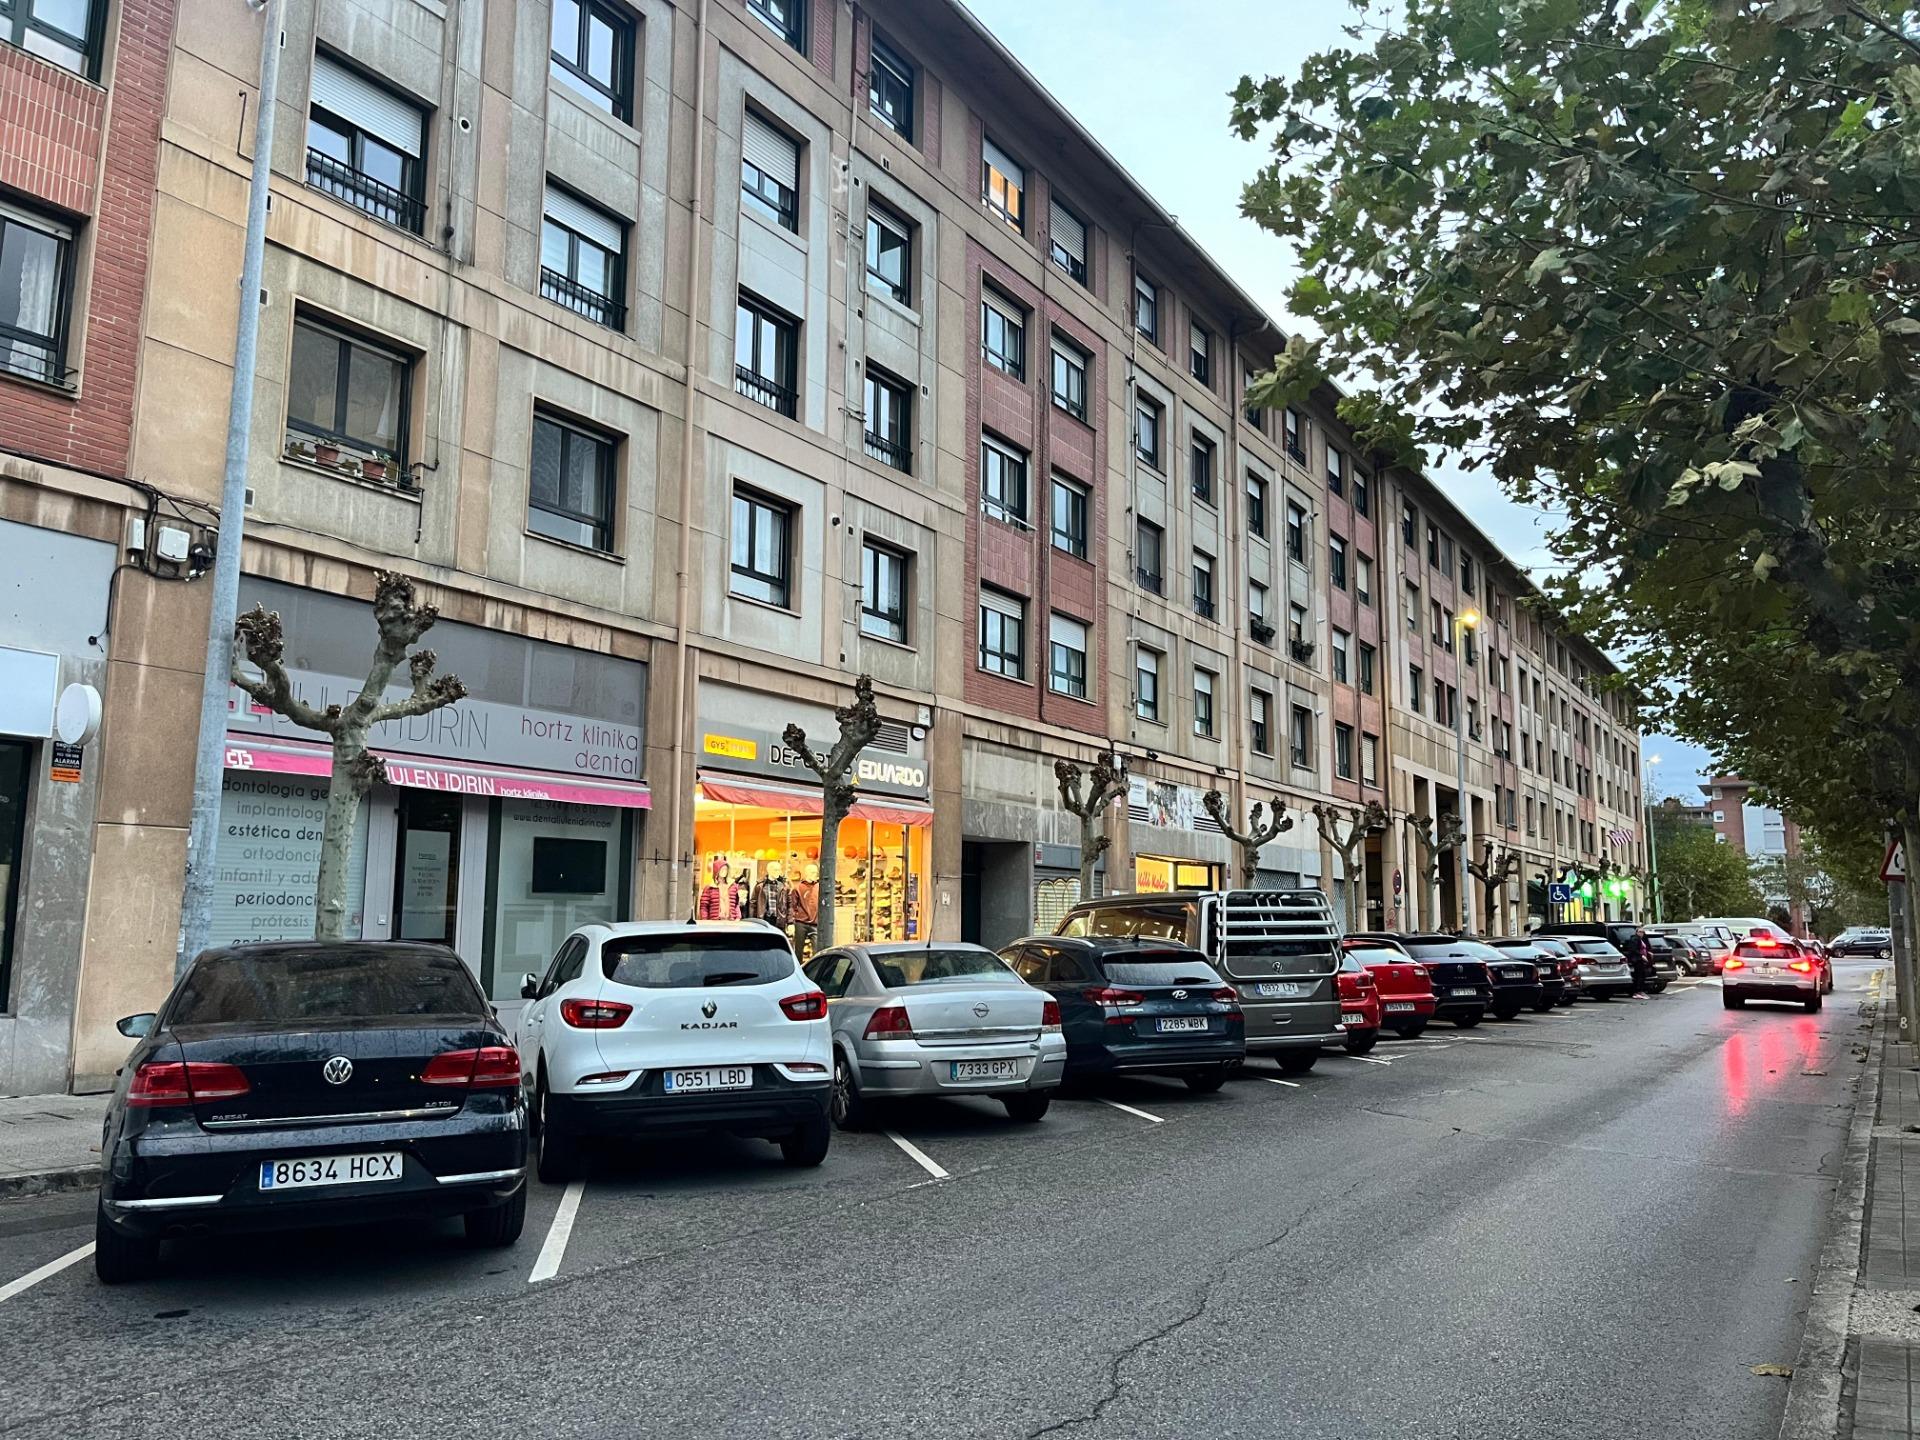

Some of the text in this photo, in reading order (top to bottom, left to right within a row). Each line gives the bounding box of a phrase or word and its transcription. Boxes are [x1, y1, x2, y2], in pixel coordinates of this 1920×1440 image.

[521, 714, 639, 751] hortz klinika
[54, 757, 80, 765] ALARMA
[575, 750, 638, 775] dental
[858, 759, 925, 788] EDUARDO
[222, 778, 305, 799] dontología
[444, 773, 495, 795] IDIRIN
[236, 801, 325, 823] implantolog
[228, 824, 323, 841] estética den
[220, 867, 272, 883] infantil
[278, 872, 286, 886] y
[235, 891, 318, 907] periodonci
[250, 914, 310, 931] prótesis
[680, 1022, 738, 1030] KADJAR
[1162, 1018, 1186, 1030] 2285
[959, 1061, 1014, 1076] 7333 GPX
[675, 1069, 746, 1088] 0551 LBD
[276, 1155, 395, 1184] 8634 HCX
